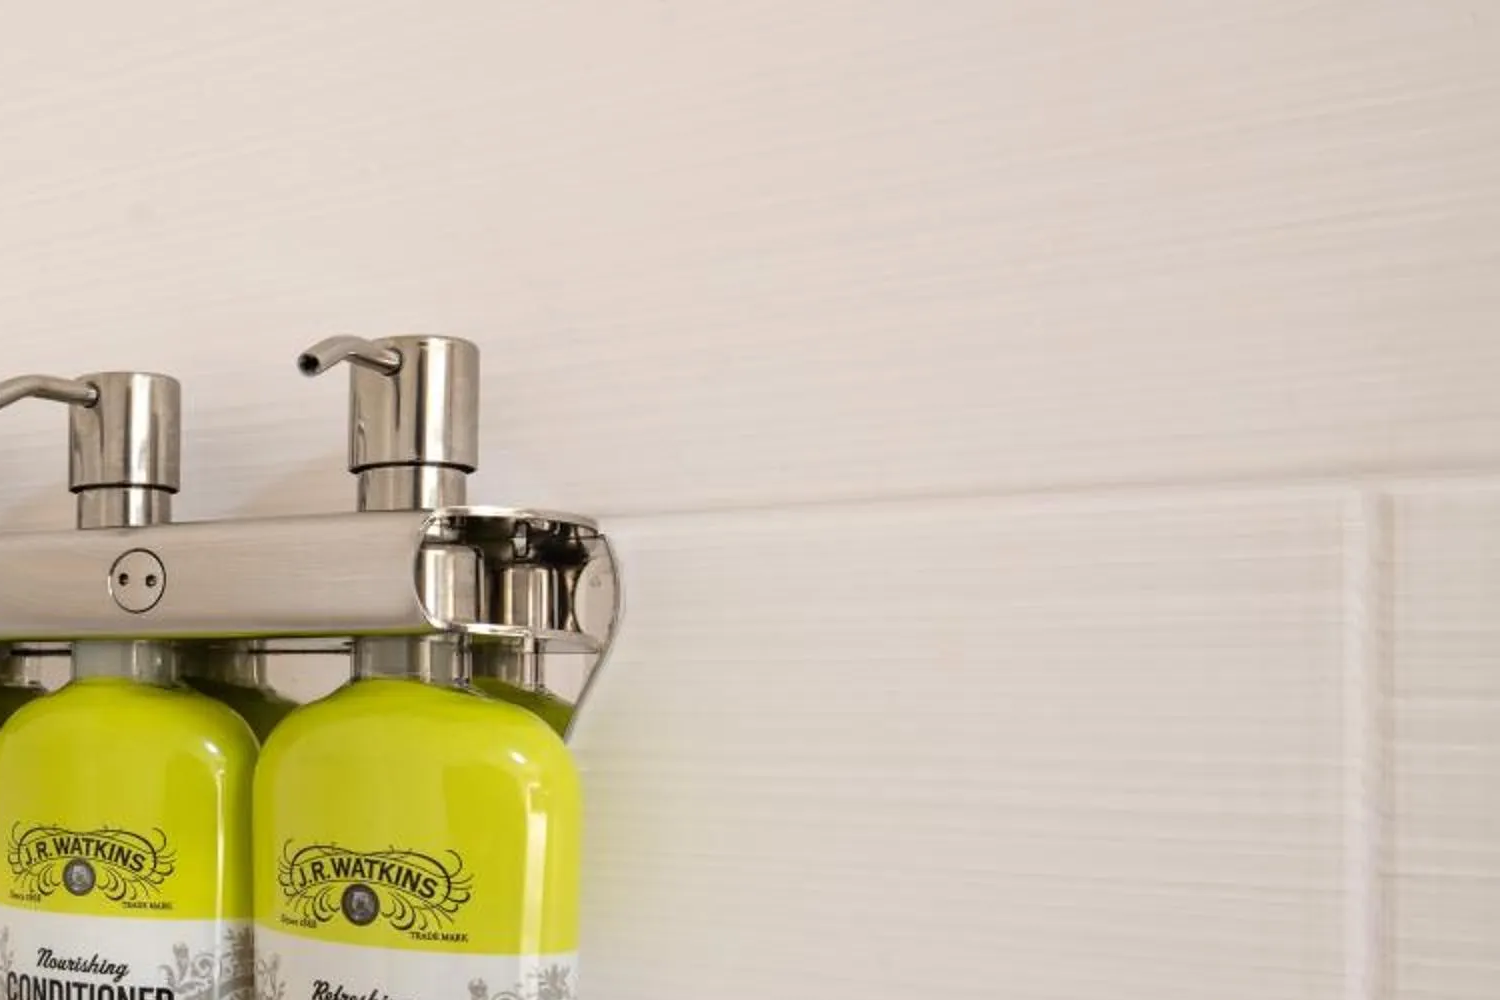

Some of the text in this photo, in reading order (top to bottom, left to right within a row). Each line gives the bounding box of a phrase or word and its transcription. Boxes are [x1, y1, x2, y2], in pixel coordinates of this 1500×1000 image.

[52, 837, 145, 872] WATKINS
[331, 857, 438, 899] WATKINS
[411, 931, 469, 942] TRADE MARK
[36, 947, 129, 982] Nourishing
